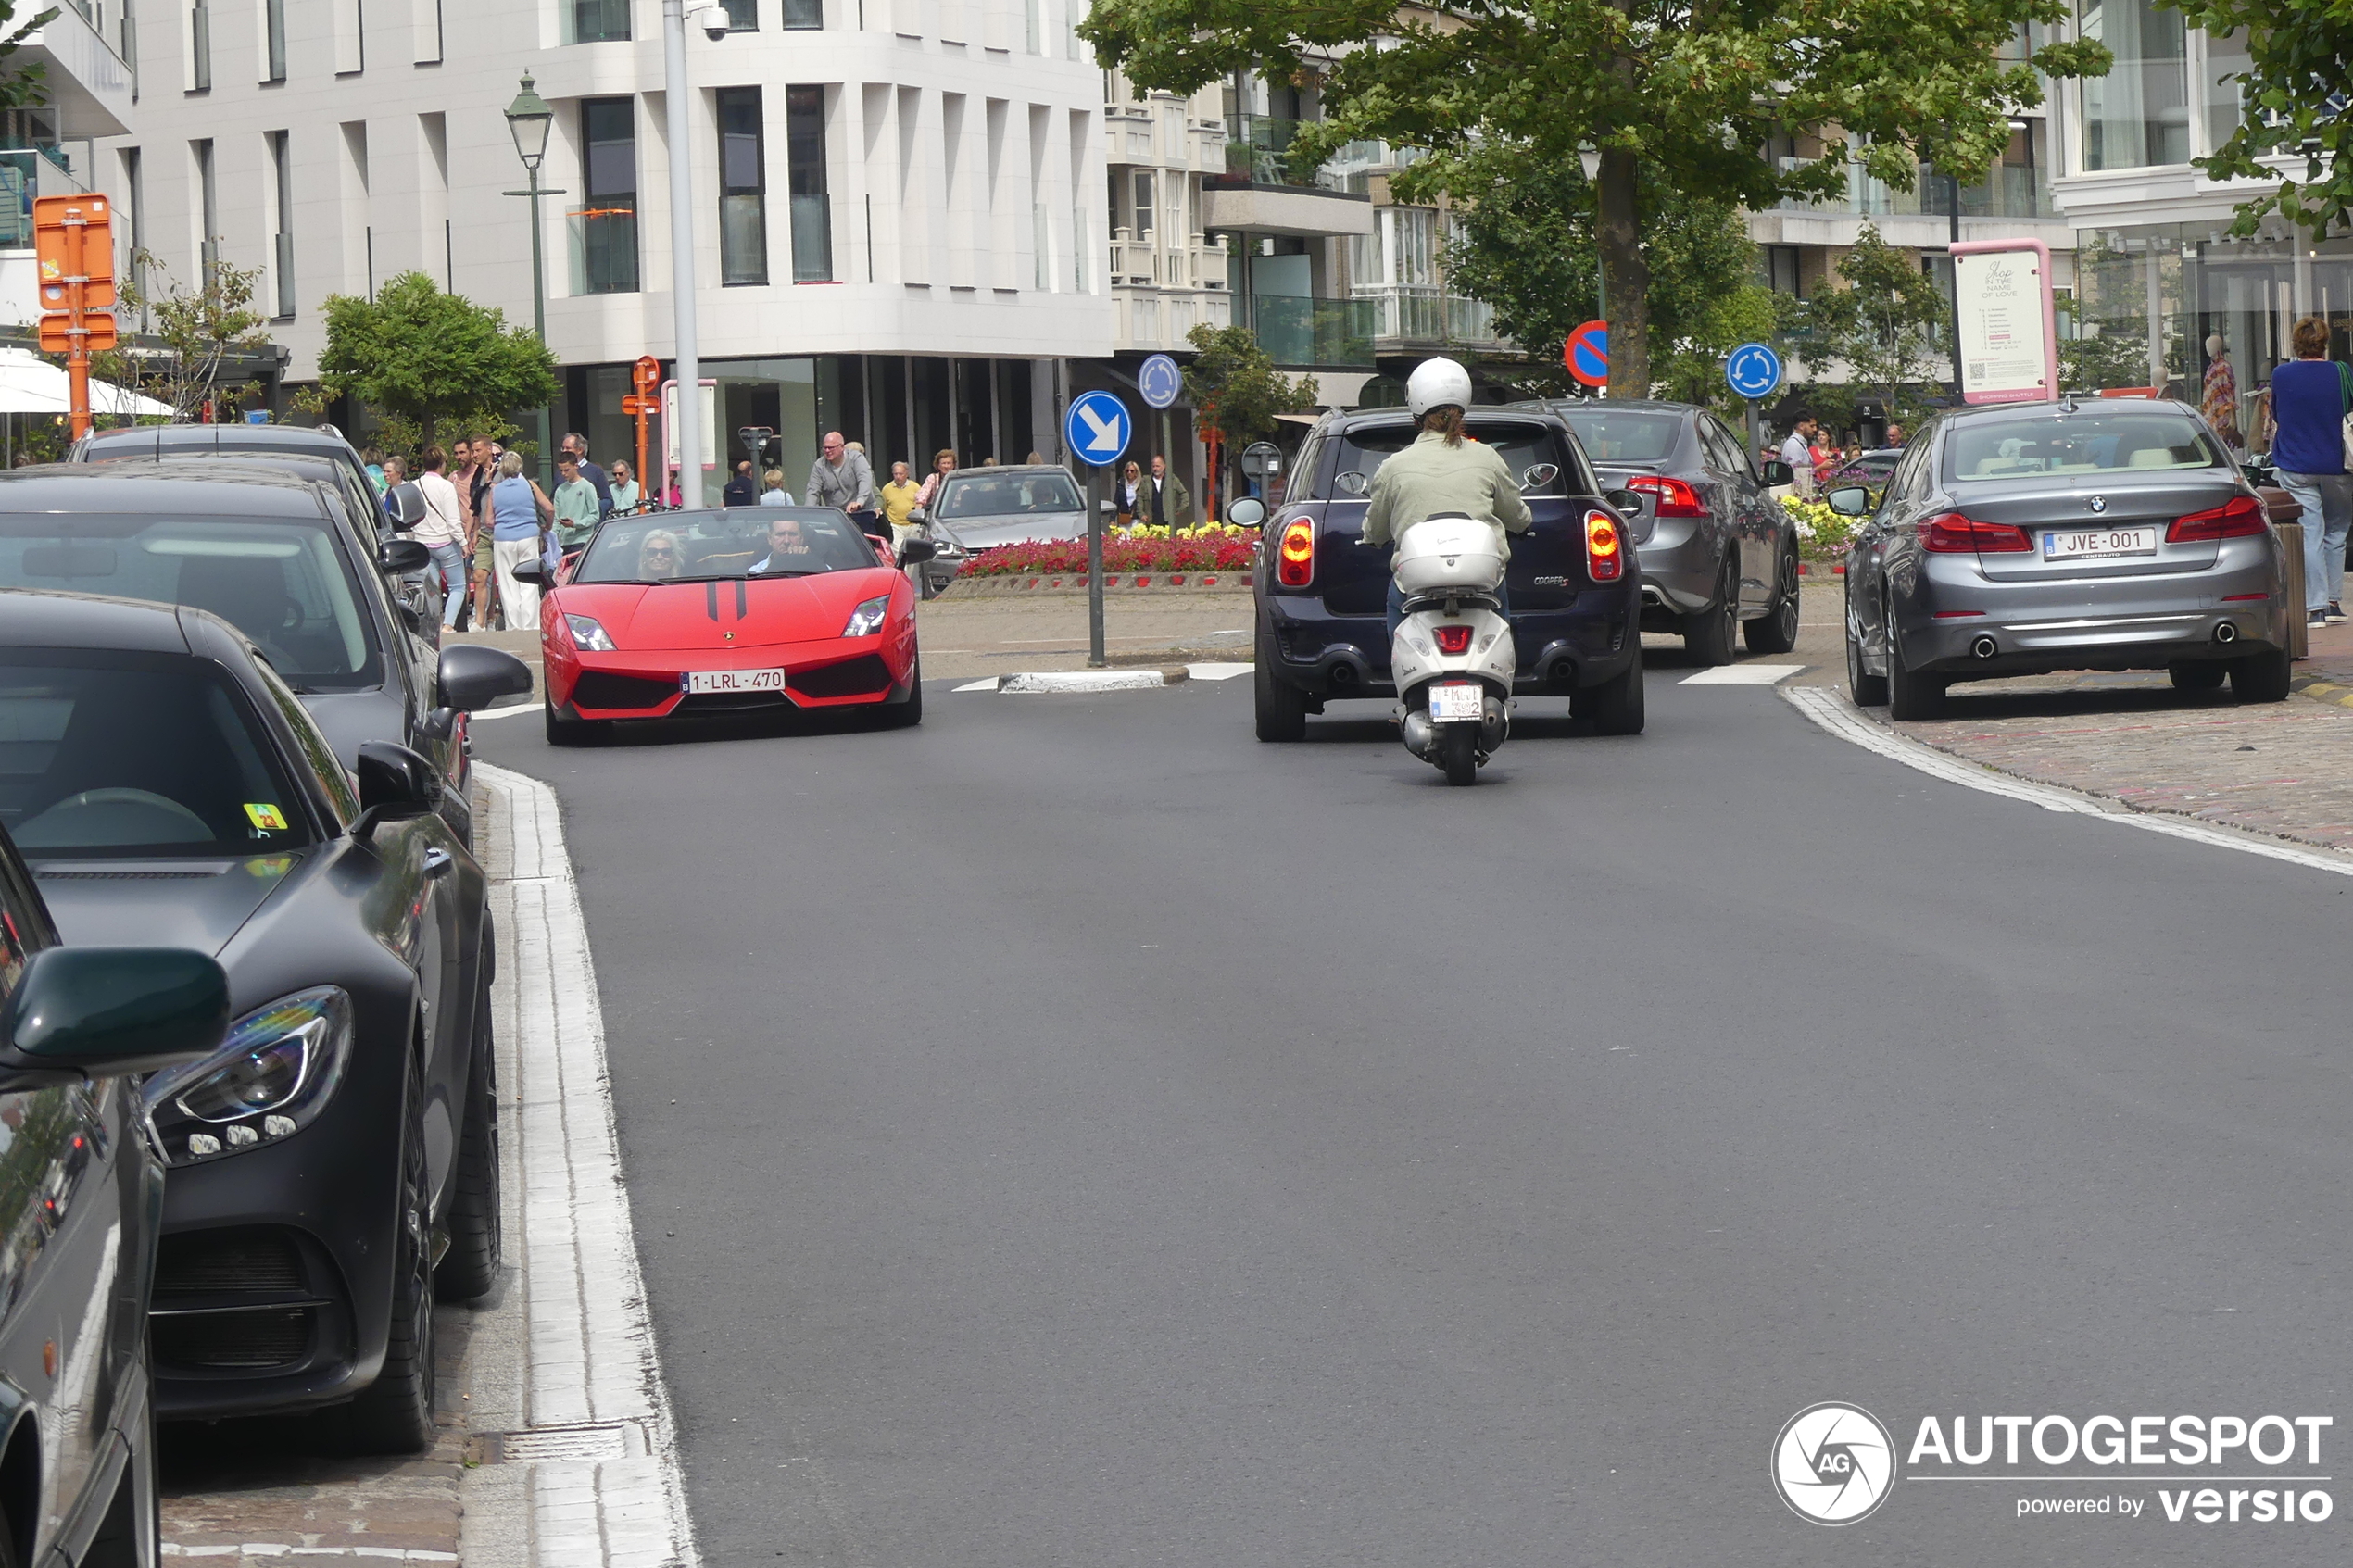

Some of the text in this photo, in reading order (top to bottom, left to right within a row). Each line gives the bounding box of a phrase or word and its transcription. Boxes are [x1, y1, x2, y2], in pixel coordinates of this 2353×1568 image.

[1984, 260, 2015, 285] Shop
[1994, 277, 2013, 285] THE
[1995, 290, 2018, 298] LOVE
[2046, 546, 2054, 554] B
[682, 684, 689, 692] B
